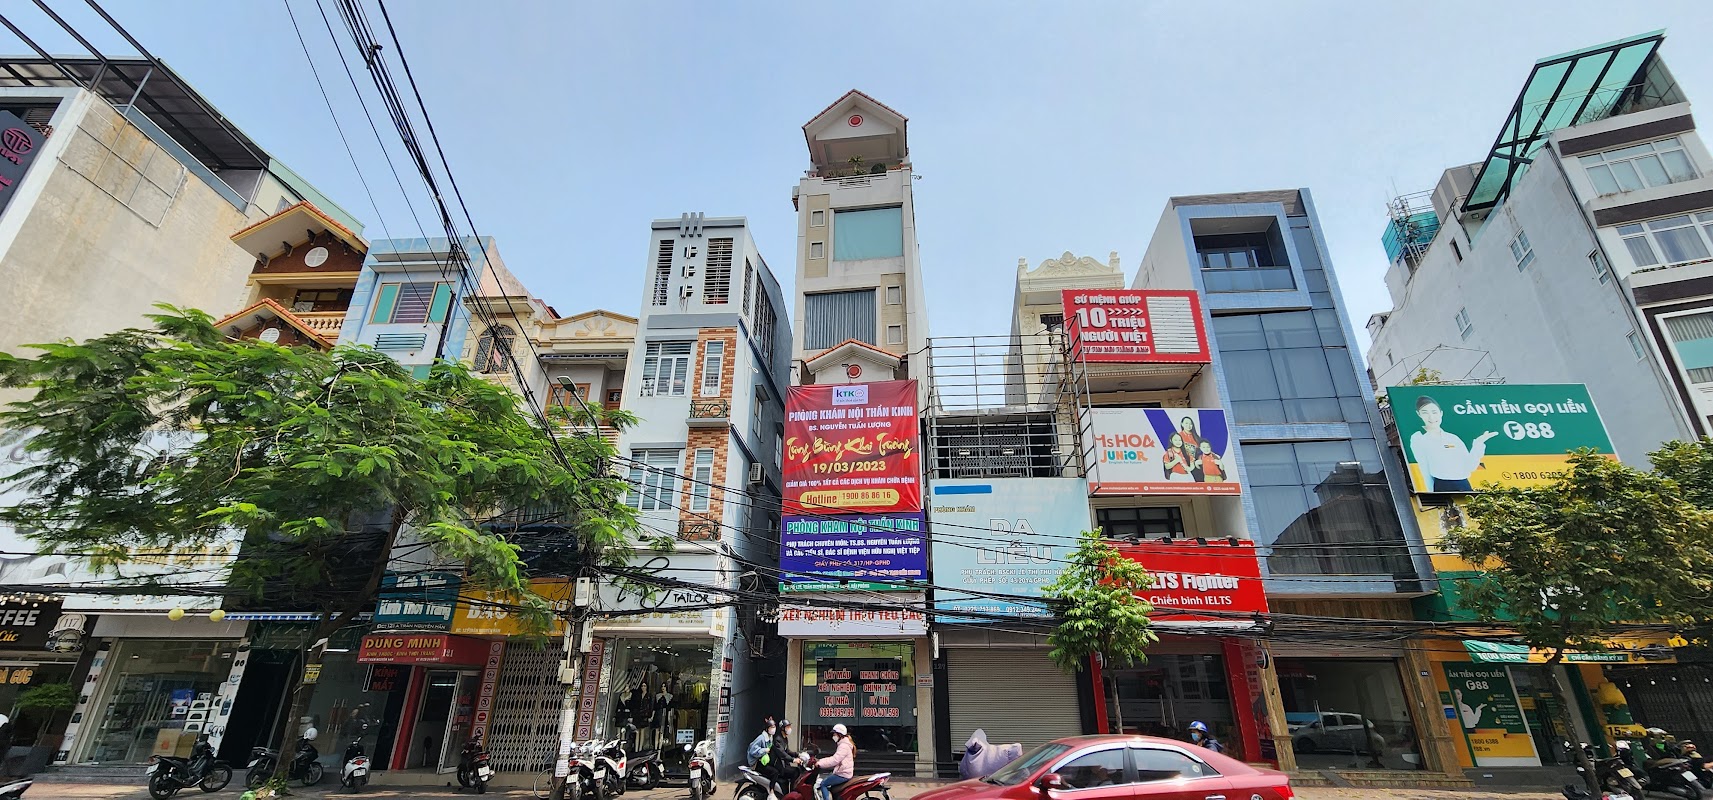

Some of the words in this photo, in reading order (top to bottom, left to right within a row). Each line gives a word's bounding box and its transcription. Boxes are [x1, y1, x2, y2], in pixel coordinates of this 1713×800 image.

[1089, 294, 1116, 305] MỆNH
[1119, 294, 1141, 304] GIÚP
[1076, 308, 1107, 327] 10
[1109, 316, 1146, 330] TRIỆU
[1081, 330, 1119, 342] NGƯỜI
[1121, 330, 1147, 343] VIỆT
[789, 408, 818, 422] PHÒNG
[820, 406, 845, 420] KHÁM
[848, 406, 864, 420] NỘI
[866, 404, 889, 418] THẦN
[892, 406, 913, 416] KINH
[1453, 400, 1486, 415] CẦN
[1488, 398, 1521, 414] TIỀN
[1525, 402, 1554, 417] GỌI
[1559, 397, 1588, 414] LIỀN
[820, 421, 847, 430] NGUYỄN
[849, 421, 866, 429] TUẤN
[1503, 420, 1556, 441] F88
[844, 436, 873, 455] Khai
[813, 461, 887, 474] 19/03/2023
[1512, 470, 1537, 481] 1800
[806, 494, 838, 505] Hotline
[842, 492, 859, 500] 1900
[882, 491, 891, 499] 16
[787, 518, 819, 535] PHÒNG
[895, 518, 920, 532] KINH
[1181, 573, 1240, 591] Fighter
[673, 593, 710, 604] TAILOR
[1150, 594, 1179, 606] Chiến
[1205, 595, 1233, 606] IELTS
[63, 618, 80, 628] 117
[407, 638, 441, 649] MINH
[860, 671, 879, 680] NHANH
[1466, 680, 1489, 691] F88
[1607, 726, 1621, 736] 15
